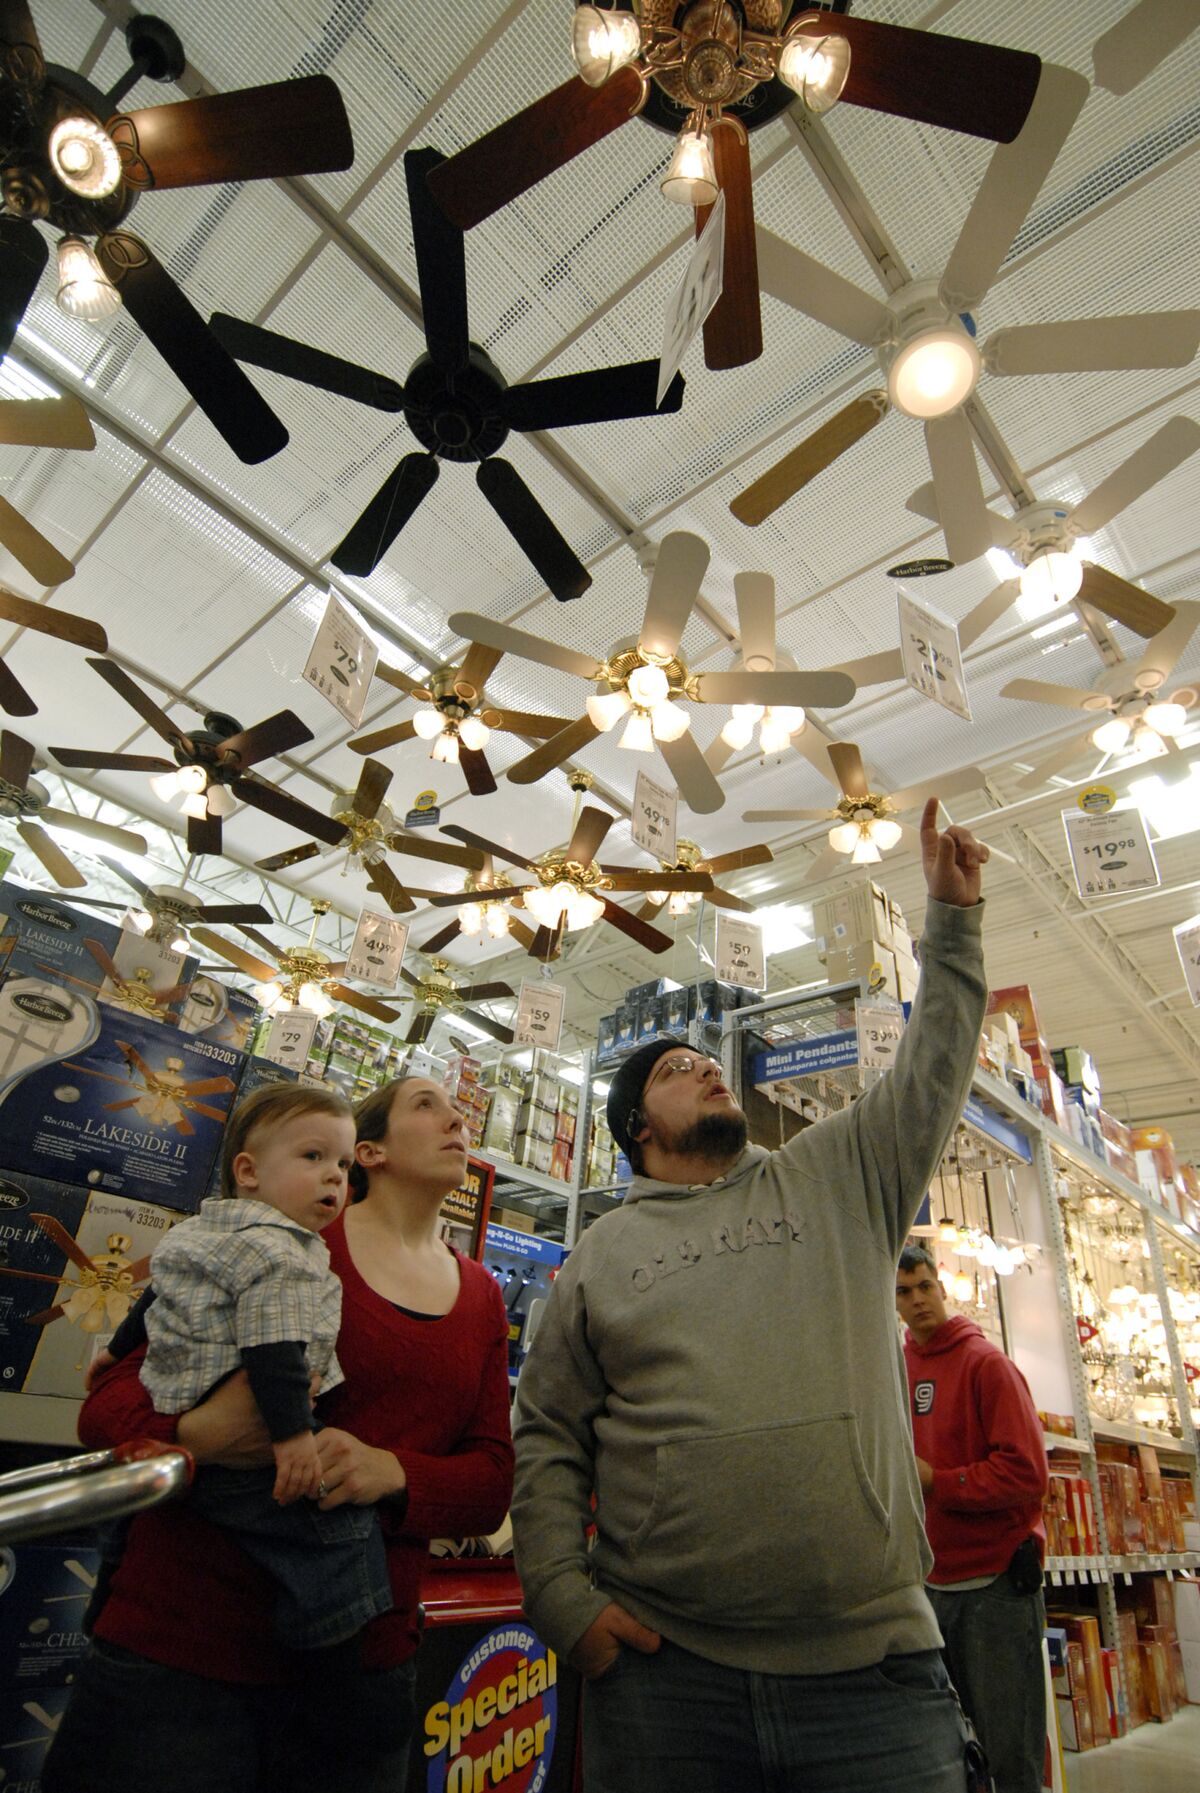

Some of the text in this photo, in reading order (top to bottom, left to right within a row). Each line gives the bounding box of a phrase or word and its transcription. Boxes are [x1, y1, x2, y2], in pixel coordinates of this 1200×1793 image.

[21, 903, 49, 920] Harbor
[18, 997, 44, 1012] Harbor
[205, 1045, 237, 1066] 33203
[766, 1039, 859, 1068] Mini Pendants
[83, 1118, 172, 1155] LAKESIDE
[173, 1143, 188, 1160] II
[136, 1212, 166, 1230] 33203
[423, 1647, 558, 1758] Special
[446, 1713, 552, 1793] Order
